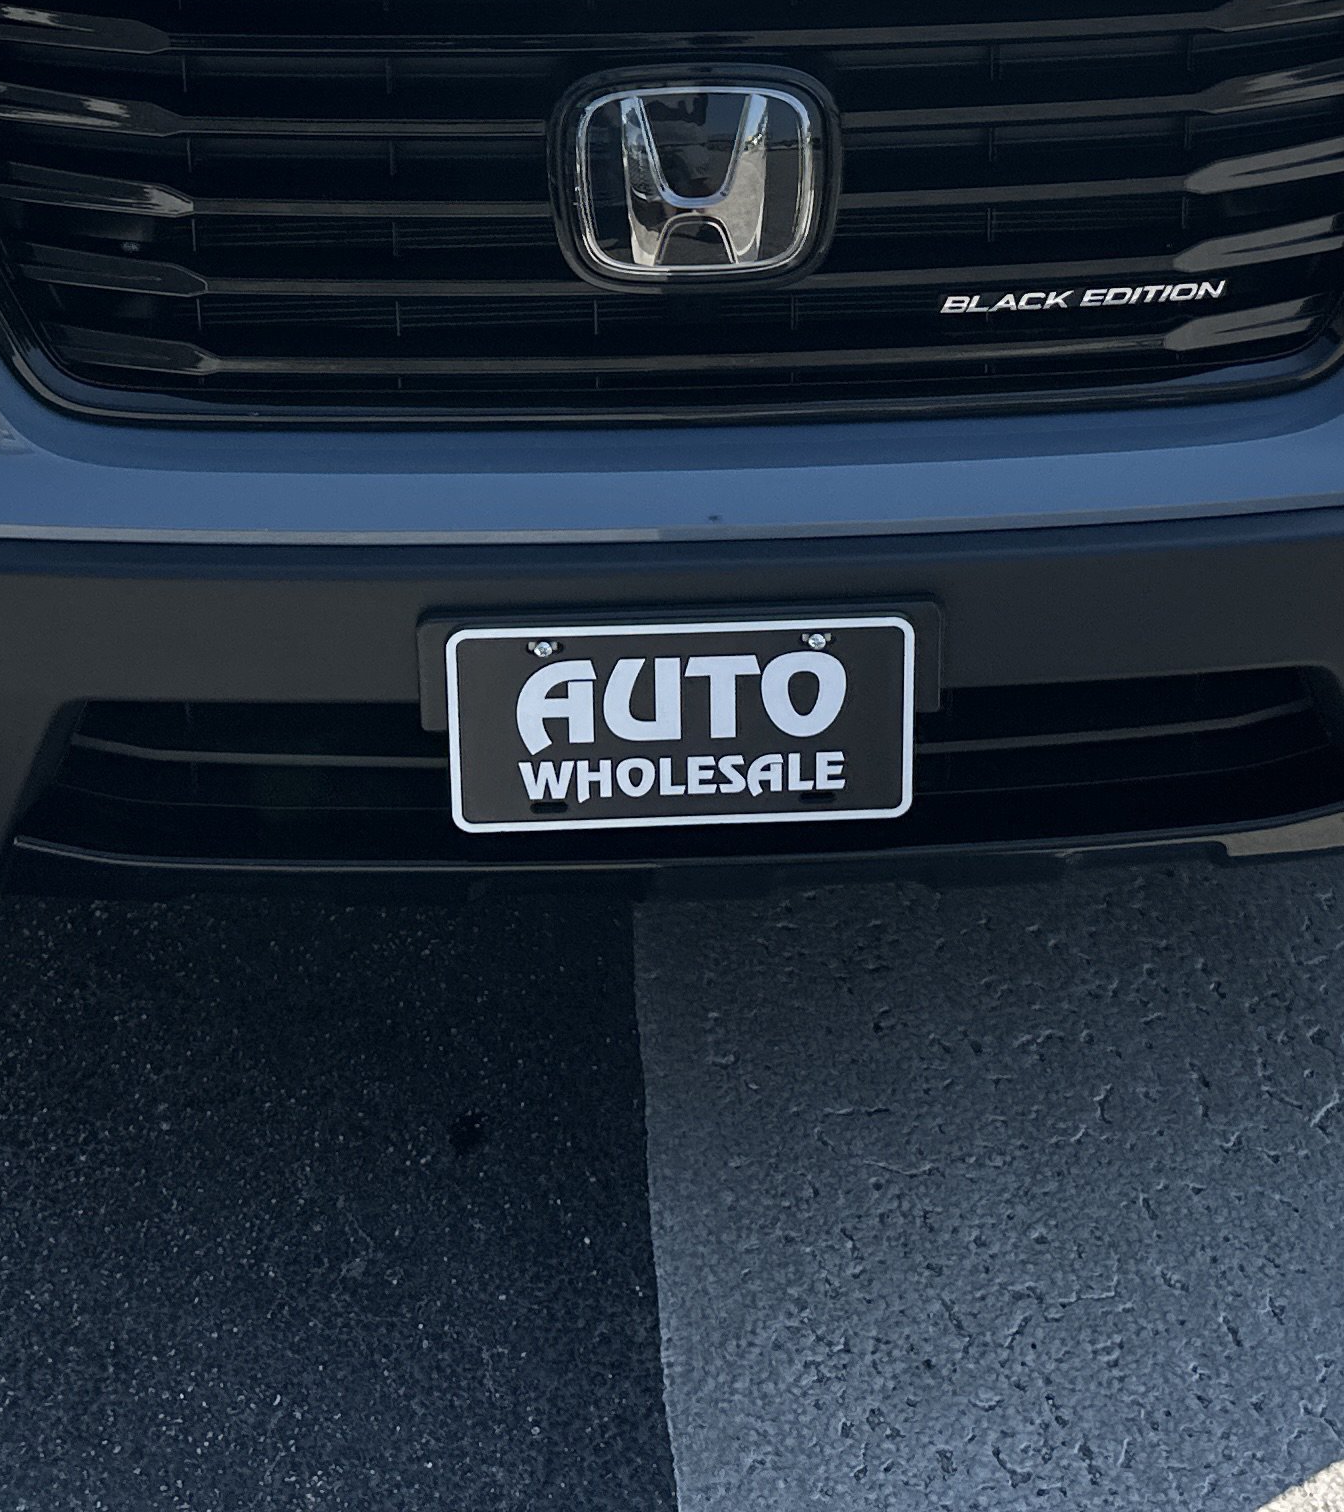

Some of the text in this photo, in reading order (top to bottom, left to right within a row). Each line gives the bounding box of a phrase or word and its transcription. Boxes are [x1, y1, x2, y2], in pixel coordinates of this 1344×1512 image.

[940, 280, 1226, 314] BLACK EDITION
[516, 650, 847, 756] AUTO
[518, 750, 846, 803] WHOLESALE
